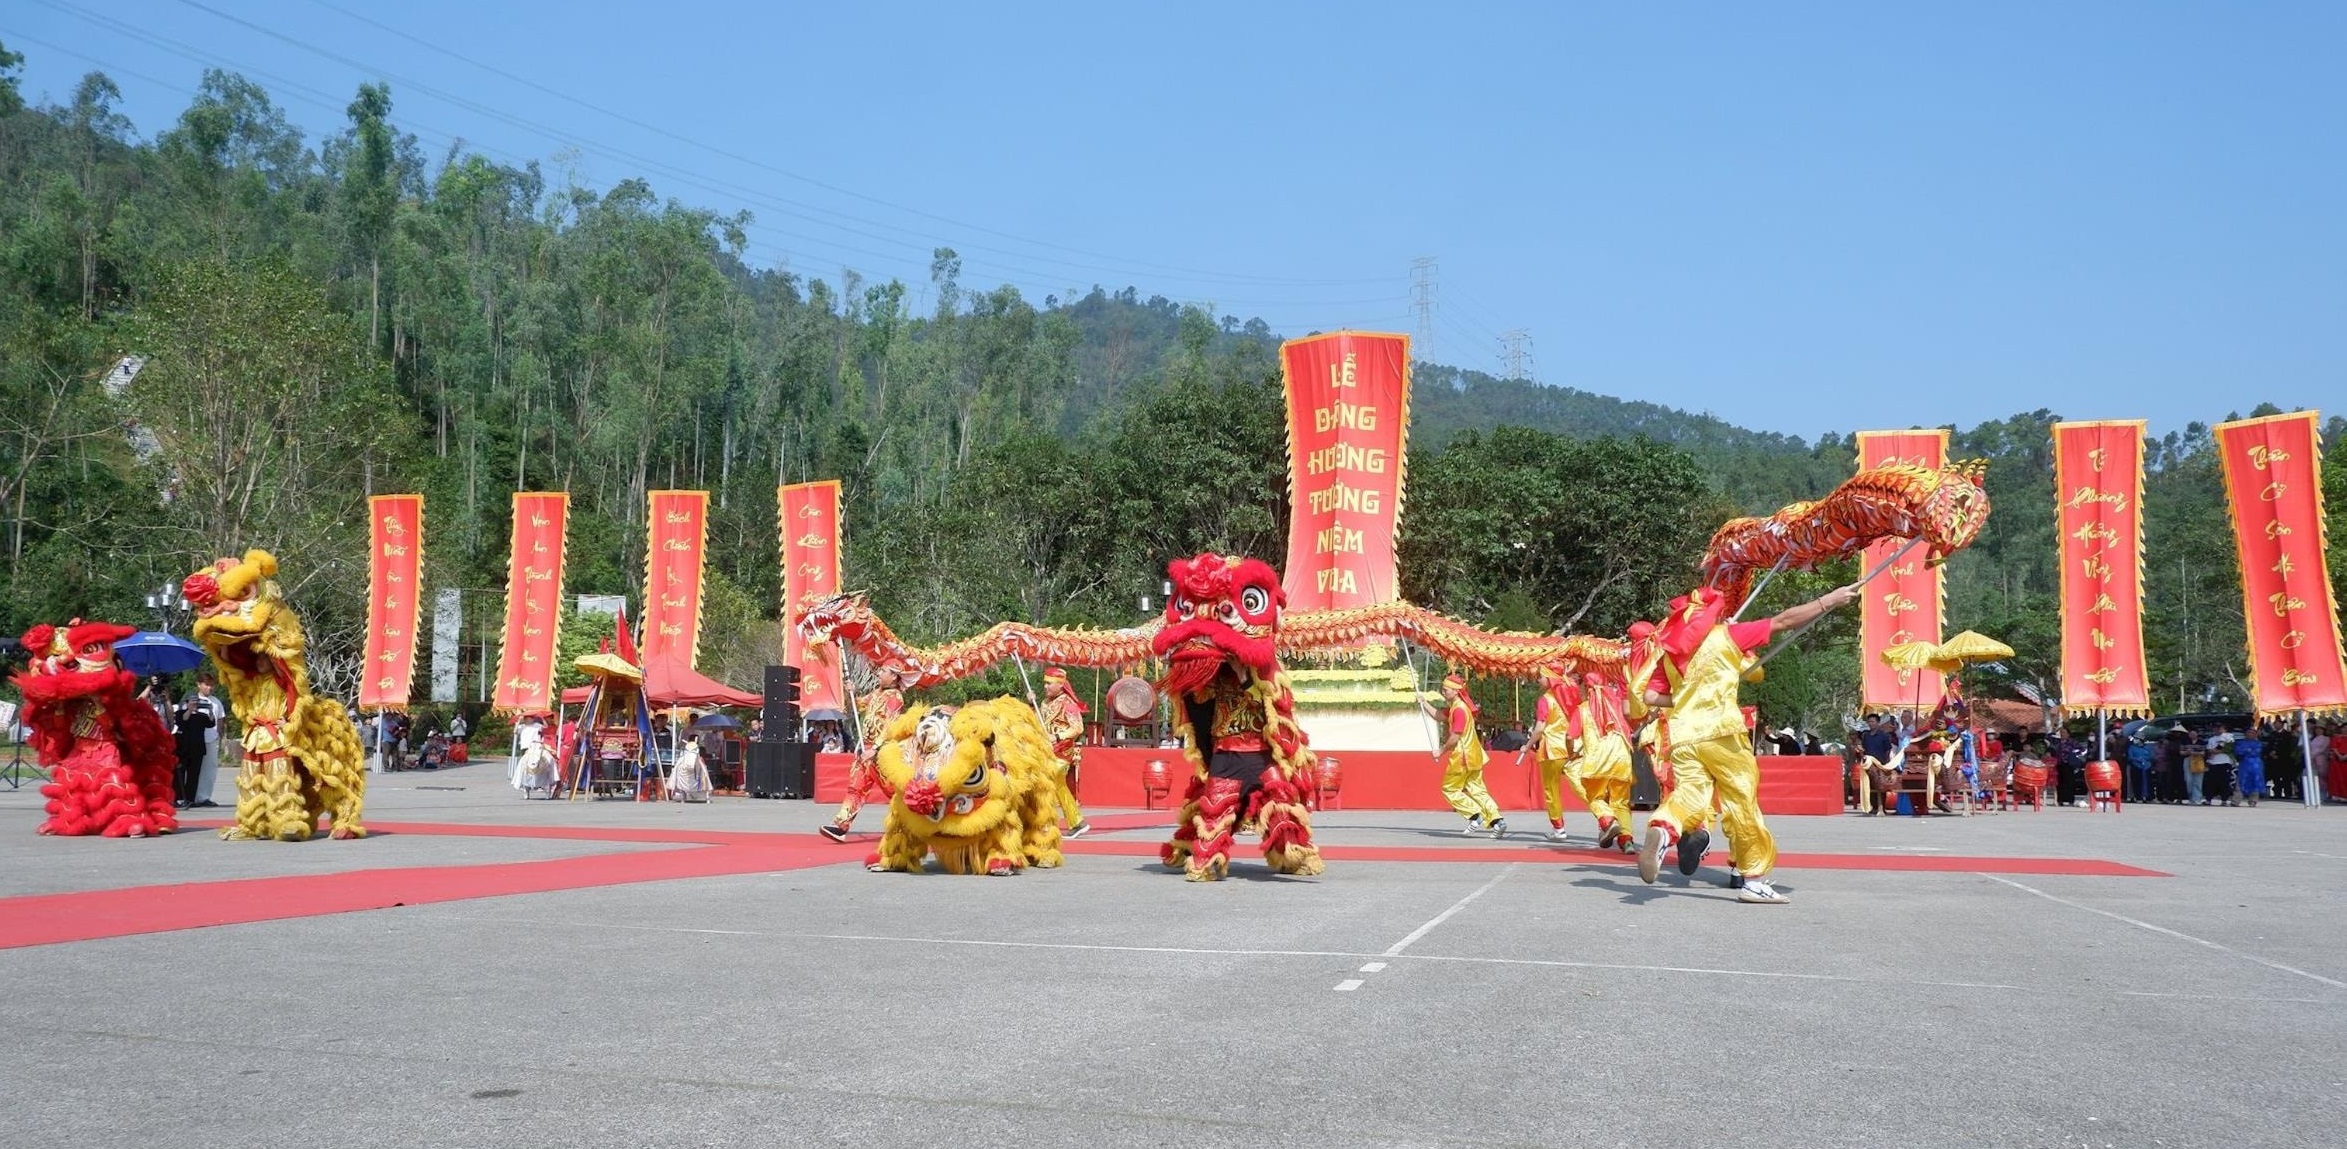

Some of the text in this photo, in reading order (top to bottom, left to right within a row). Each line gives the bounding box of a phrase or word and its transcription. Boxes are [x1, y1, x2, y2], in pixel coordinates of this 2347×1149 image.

[1330, 352, 1357, 389] LỄ
[1314, 399, 1377, 433] DÂNG
[1307, 441, 1385, 475] HƯƠNG
[2246, 444, 2292, 471] Thiên
[1309, 479, 1381, 515] TƯỞNG
[2064, 486, 2131, 514] Phương
[1316, 520, 1365, 556] NIỆM
[1317, 567, 1359, 596] VUA
[2268, 592, 2308, 618] Thiên
